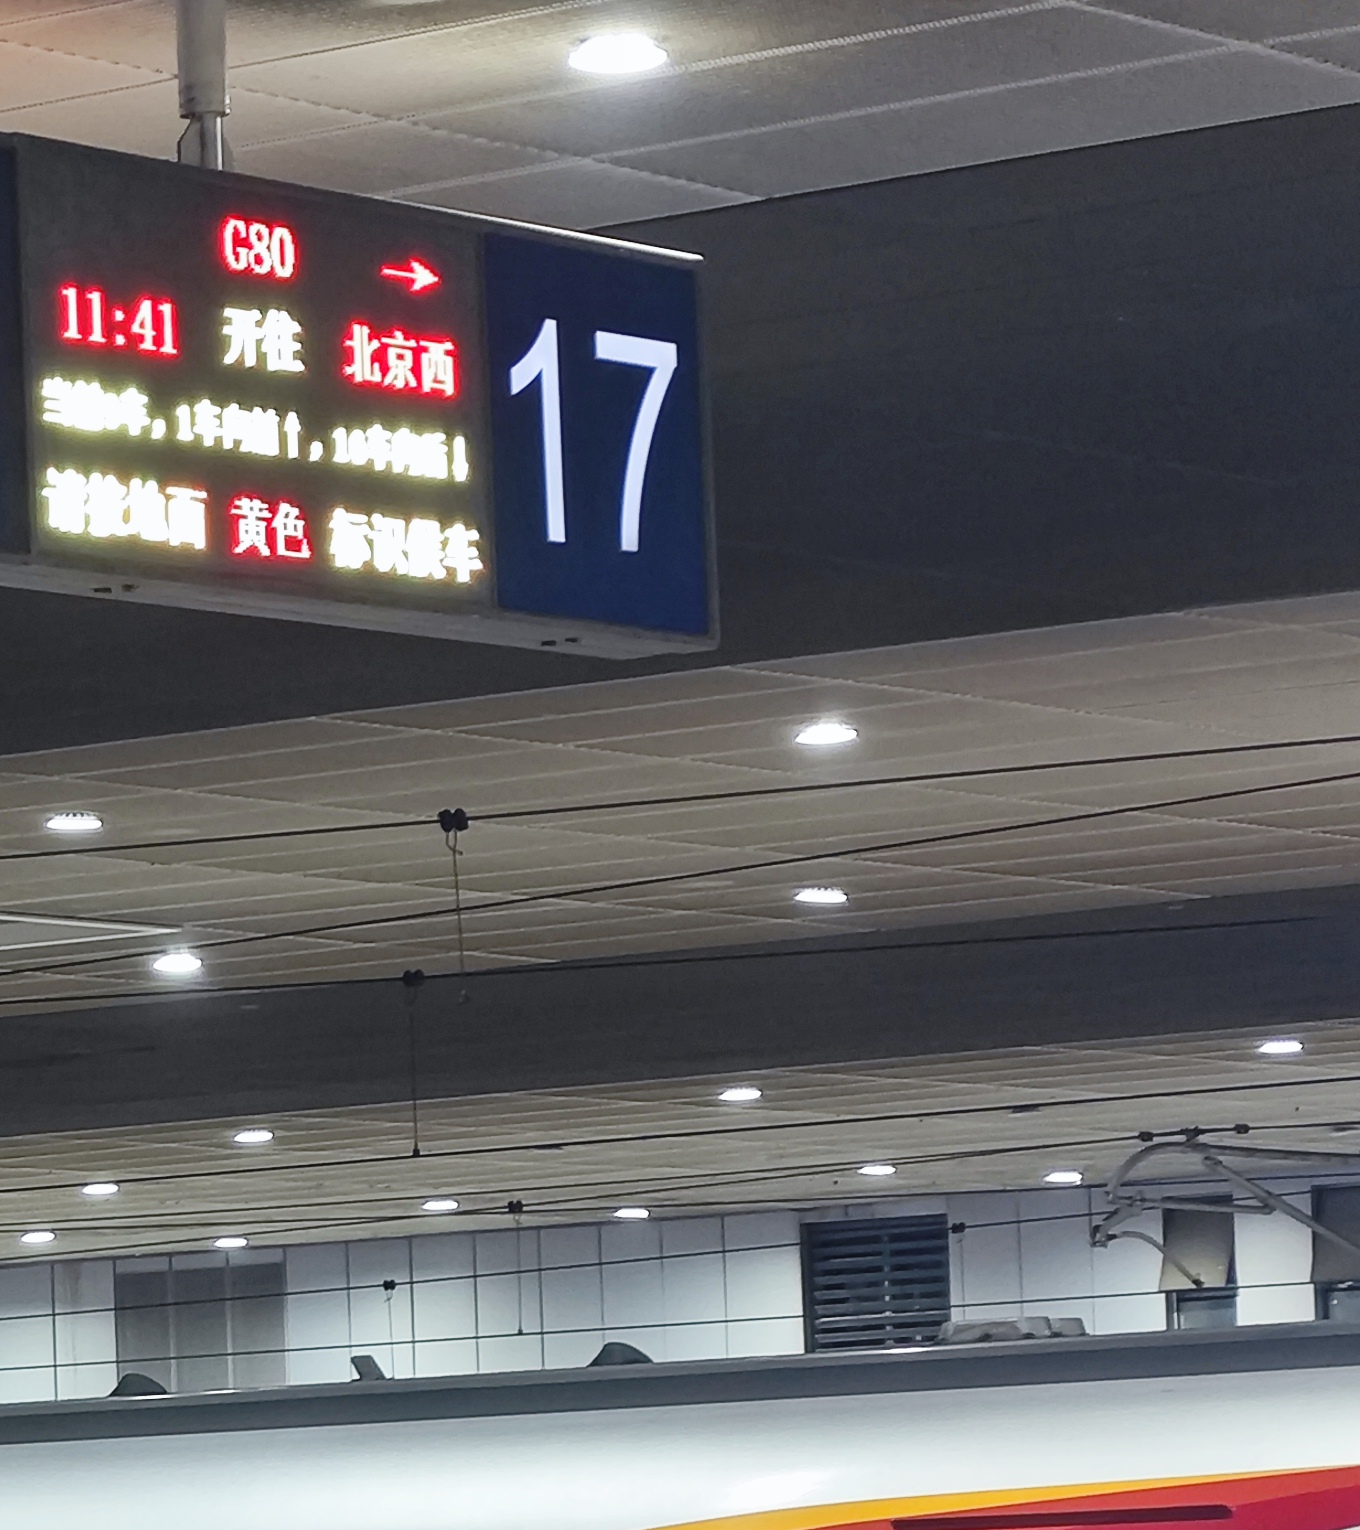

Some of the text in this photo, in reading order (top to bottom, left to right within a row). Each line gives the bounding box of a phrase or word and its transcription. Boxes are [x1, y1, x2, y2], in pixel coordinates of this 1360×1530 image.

[223, 218, 296, 279] G80
[61, 286, 179, 355] 11:41
[343, 322, 456, 398] 北京西
[509, 317, 679, 553] 17
[230, 497, 312, 560] 黄色
